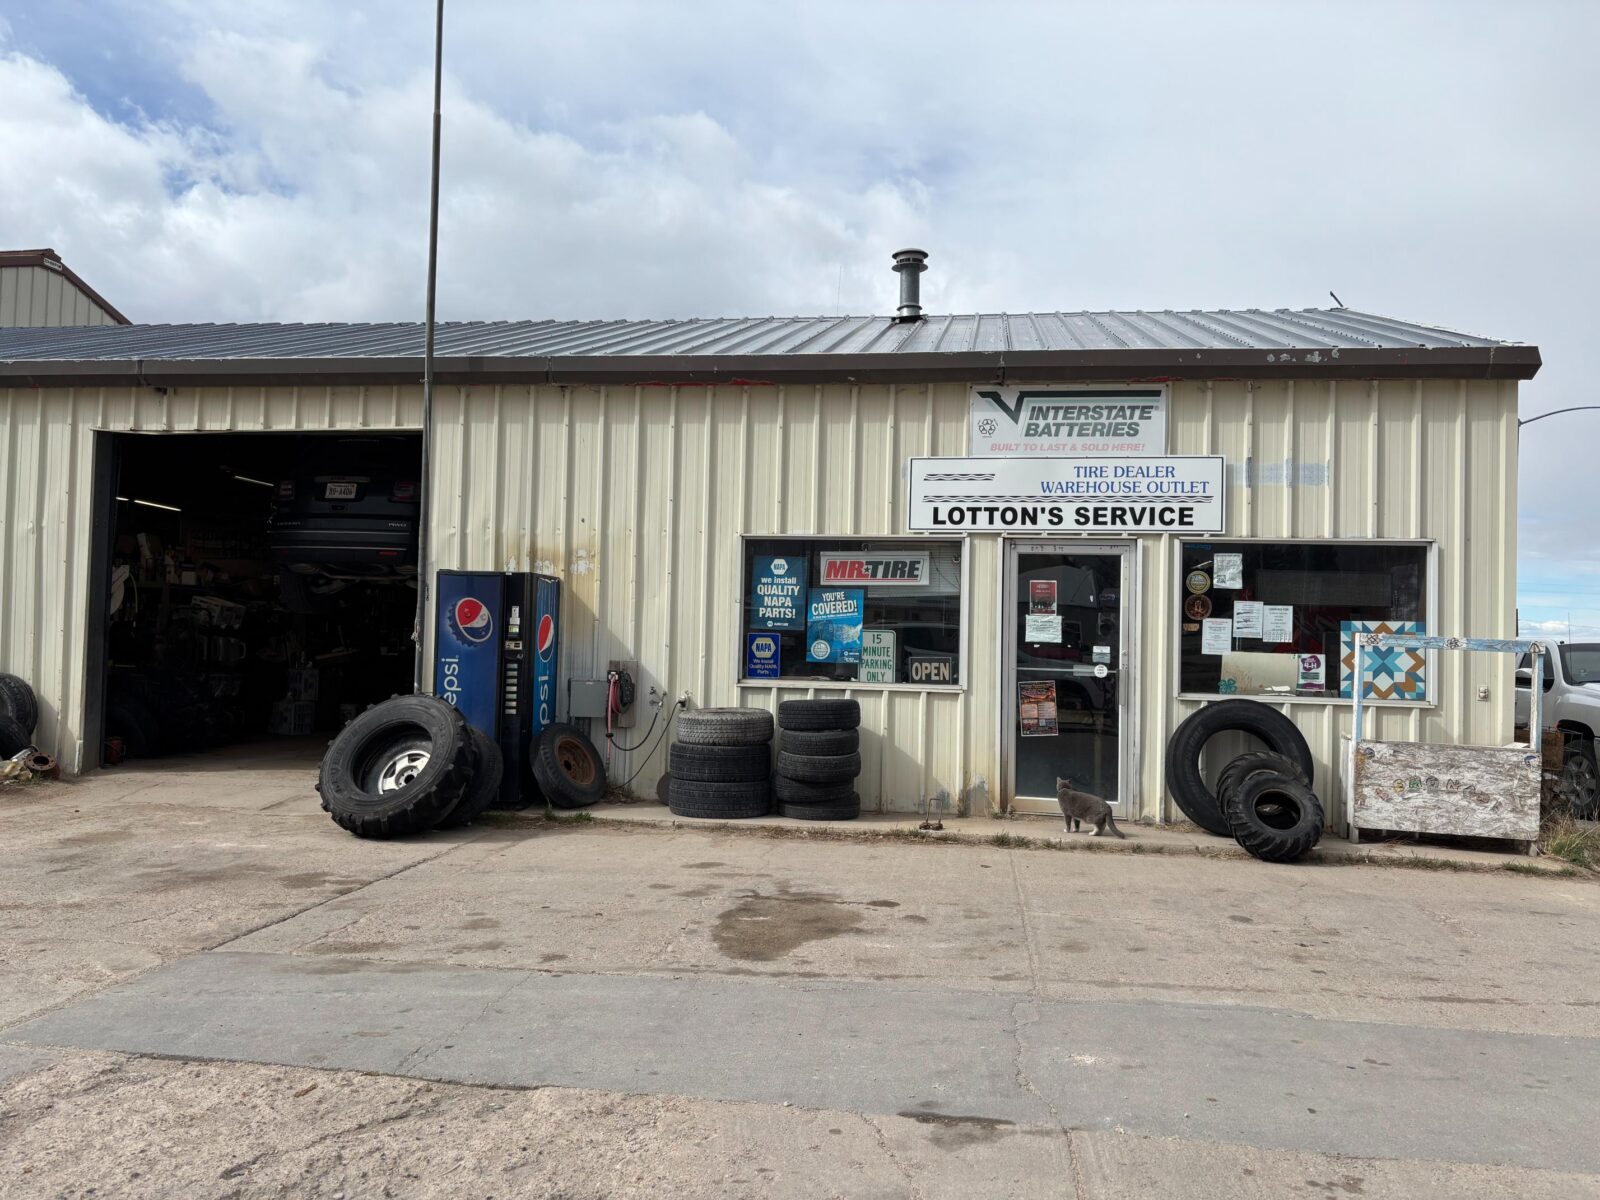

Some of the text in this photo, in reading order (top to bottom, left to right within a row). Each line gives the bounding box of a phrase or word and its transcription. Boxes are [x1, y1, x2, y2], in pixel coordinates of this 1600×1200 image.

[1028, 405, 1153, 420] INTERSTATE
[1024, 422, 1140, 437] BATTERIES
[990, 443, 1145, 451] BUILT TO LAST & SOLD HERE!
[1074, 466, 1176, 478] TIRE DEALER
[1040, 481, 1210, 494] WAREHOUSE OUTLET
[932, 506, 1194, 526] LOTTON'S SERVICE
[773, 563, 786, 571] NAPA
[773, 576, 797, 584] install
[757, 584, 800, 596] QUALITY
[764, 596, 792, 607] NAPA
[821, 591, 846, 602] YOU'RE
[759, 607, 796, 619] PARTS!
[811, 600, 858, 615] COVERED!
[872, 634, 882, 644] 15
[755, 642, 772, 653] NAPA
[862, 646, 891, 657] MINUTE
[860, 659, 892, 670] PARKING
[866, 671, 886, 682] ONLY
[911, 662, 950, 681] OPEN
[441, 658, 462, 706] epsi
